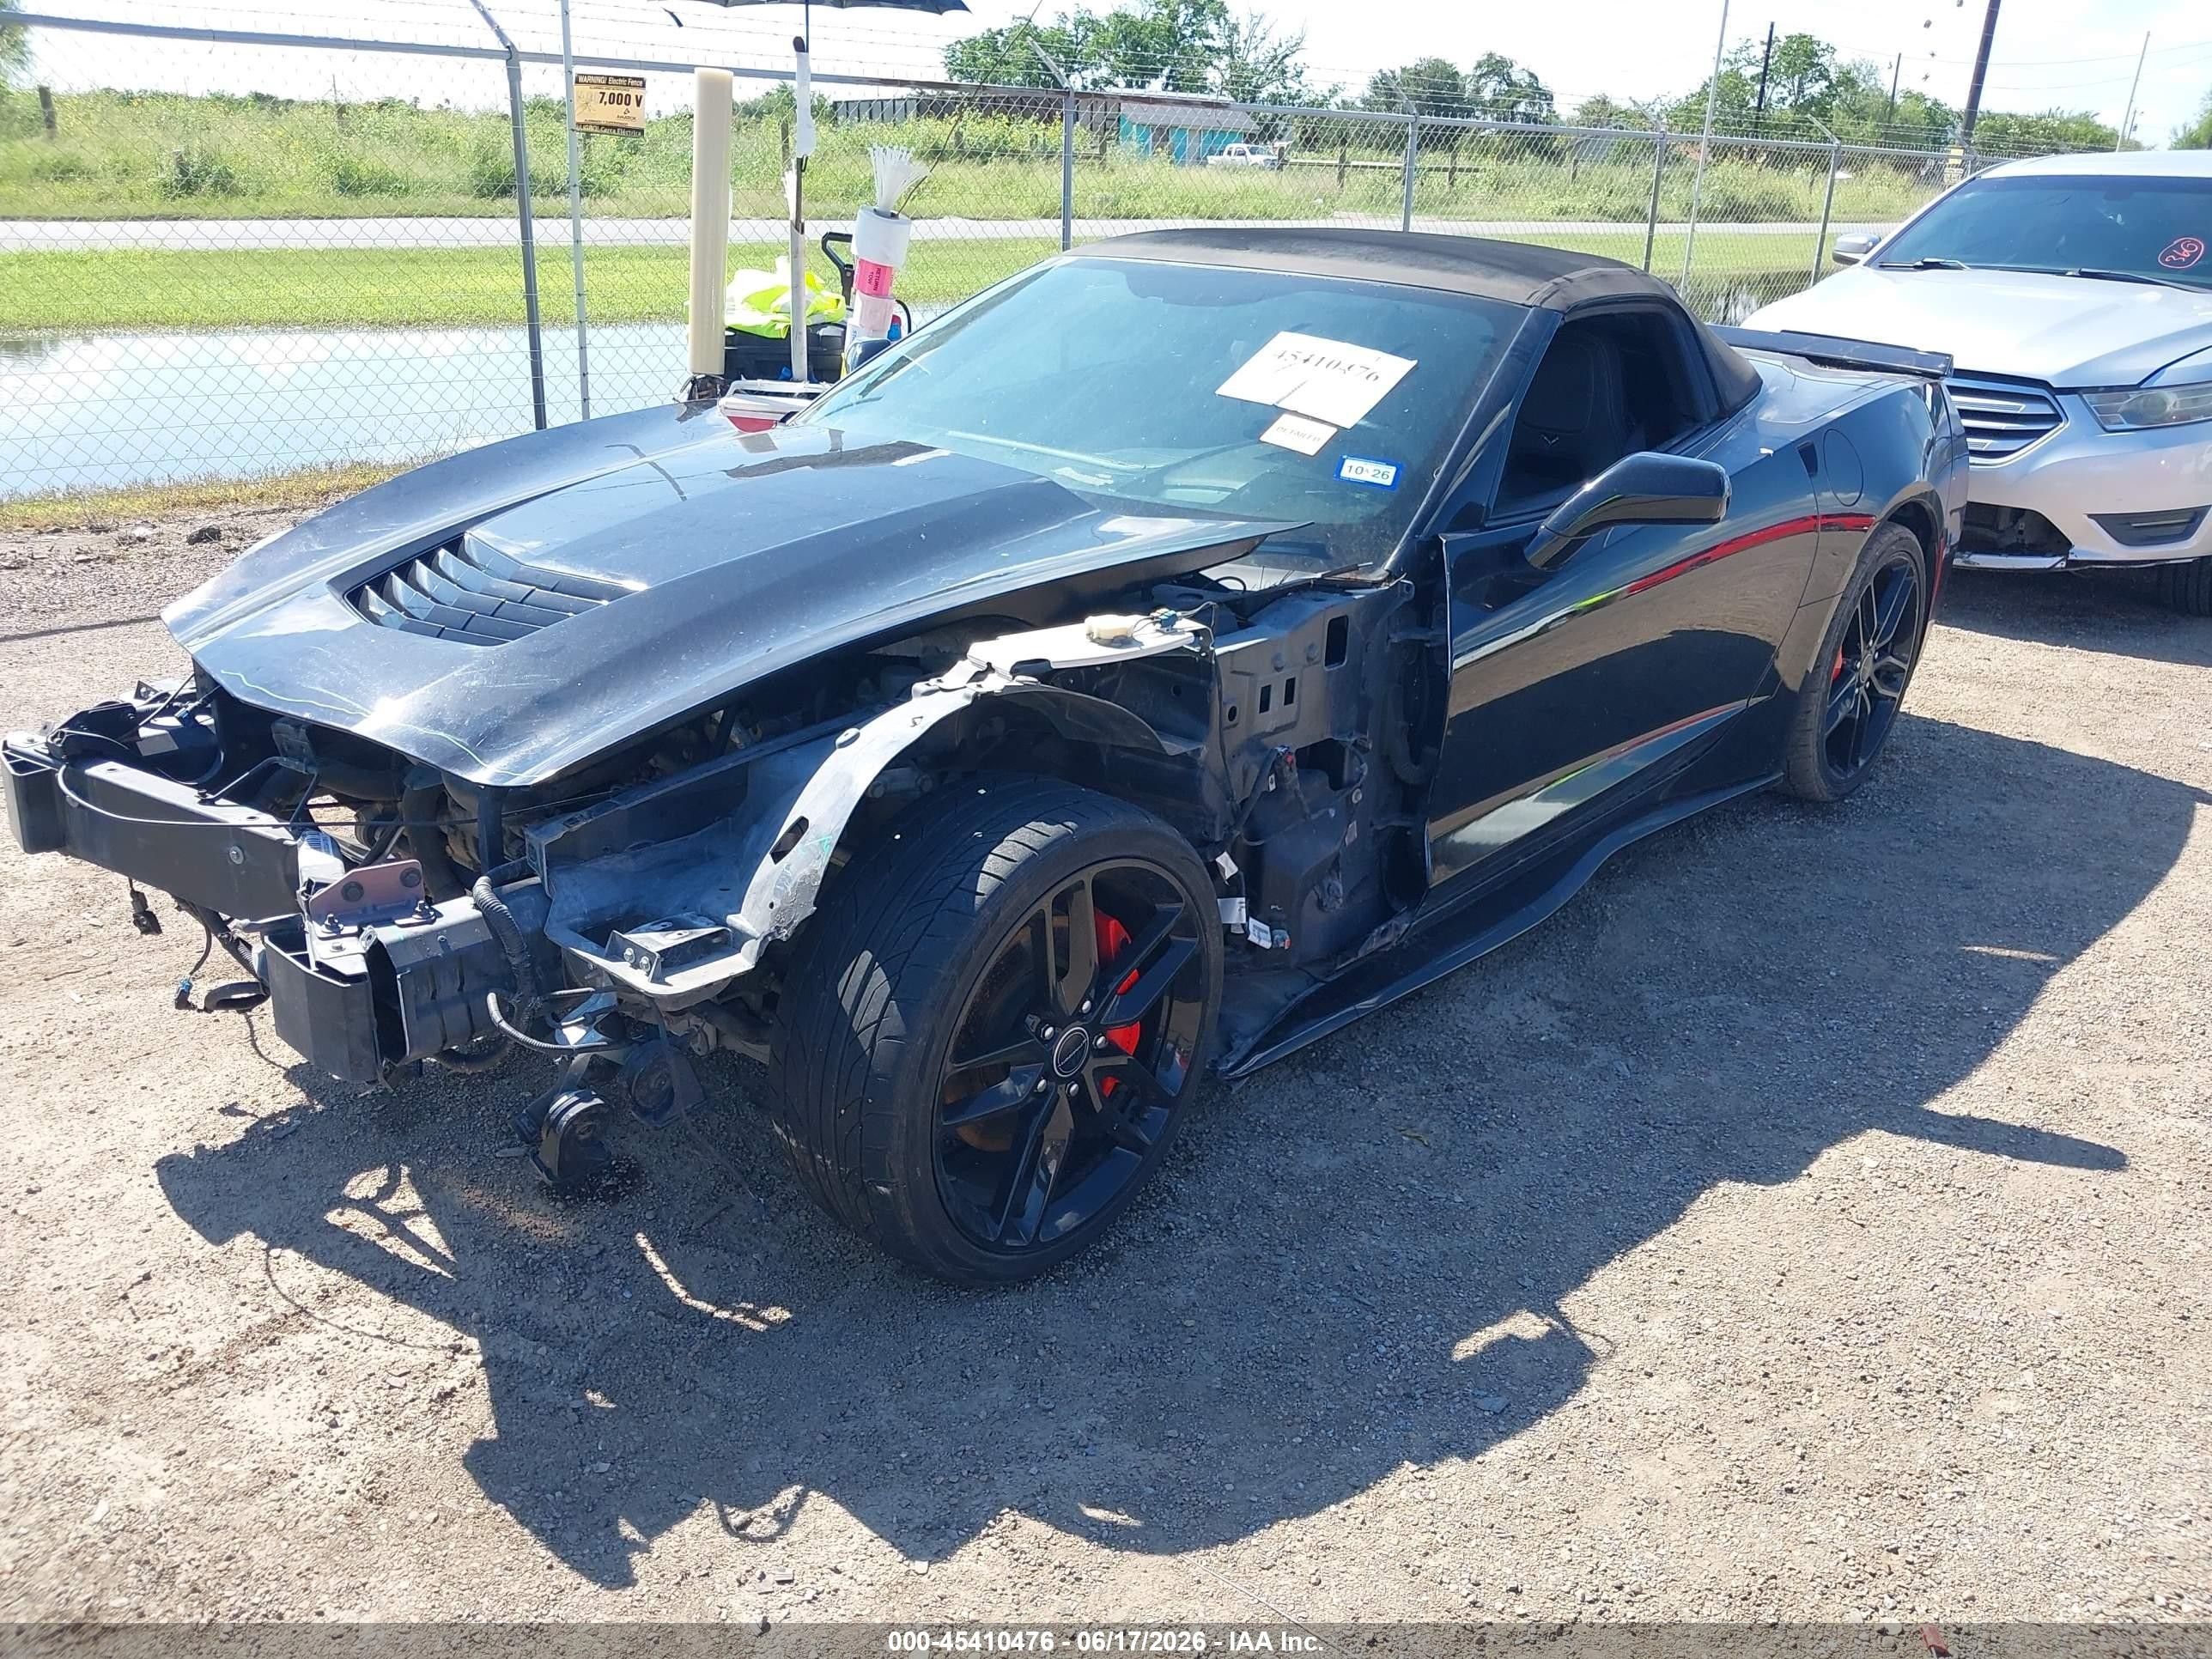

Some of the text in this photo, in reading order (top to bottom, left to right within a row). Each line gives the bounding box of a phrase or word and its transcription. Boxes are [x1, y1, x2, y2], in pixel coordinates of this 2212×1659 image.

[578, 75, 643, 87] WARNING! Electric Fence
[599, 92, 642, 107] 7,000 V
[1347, 465, 1390, 480] 10 26
